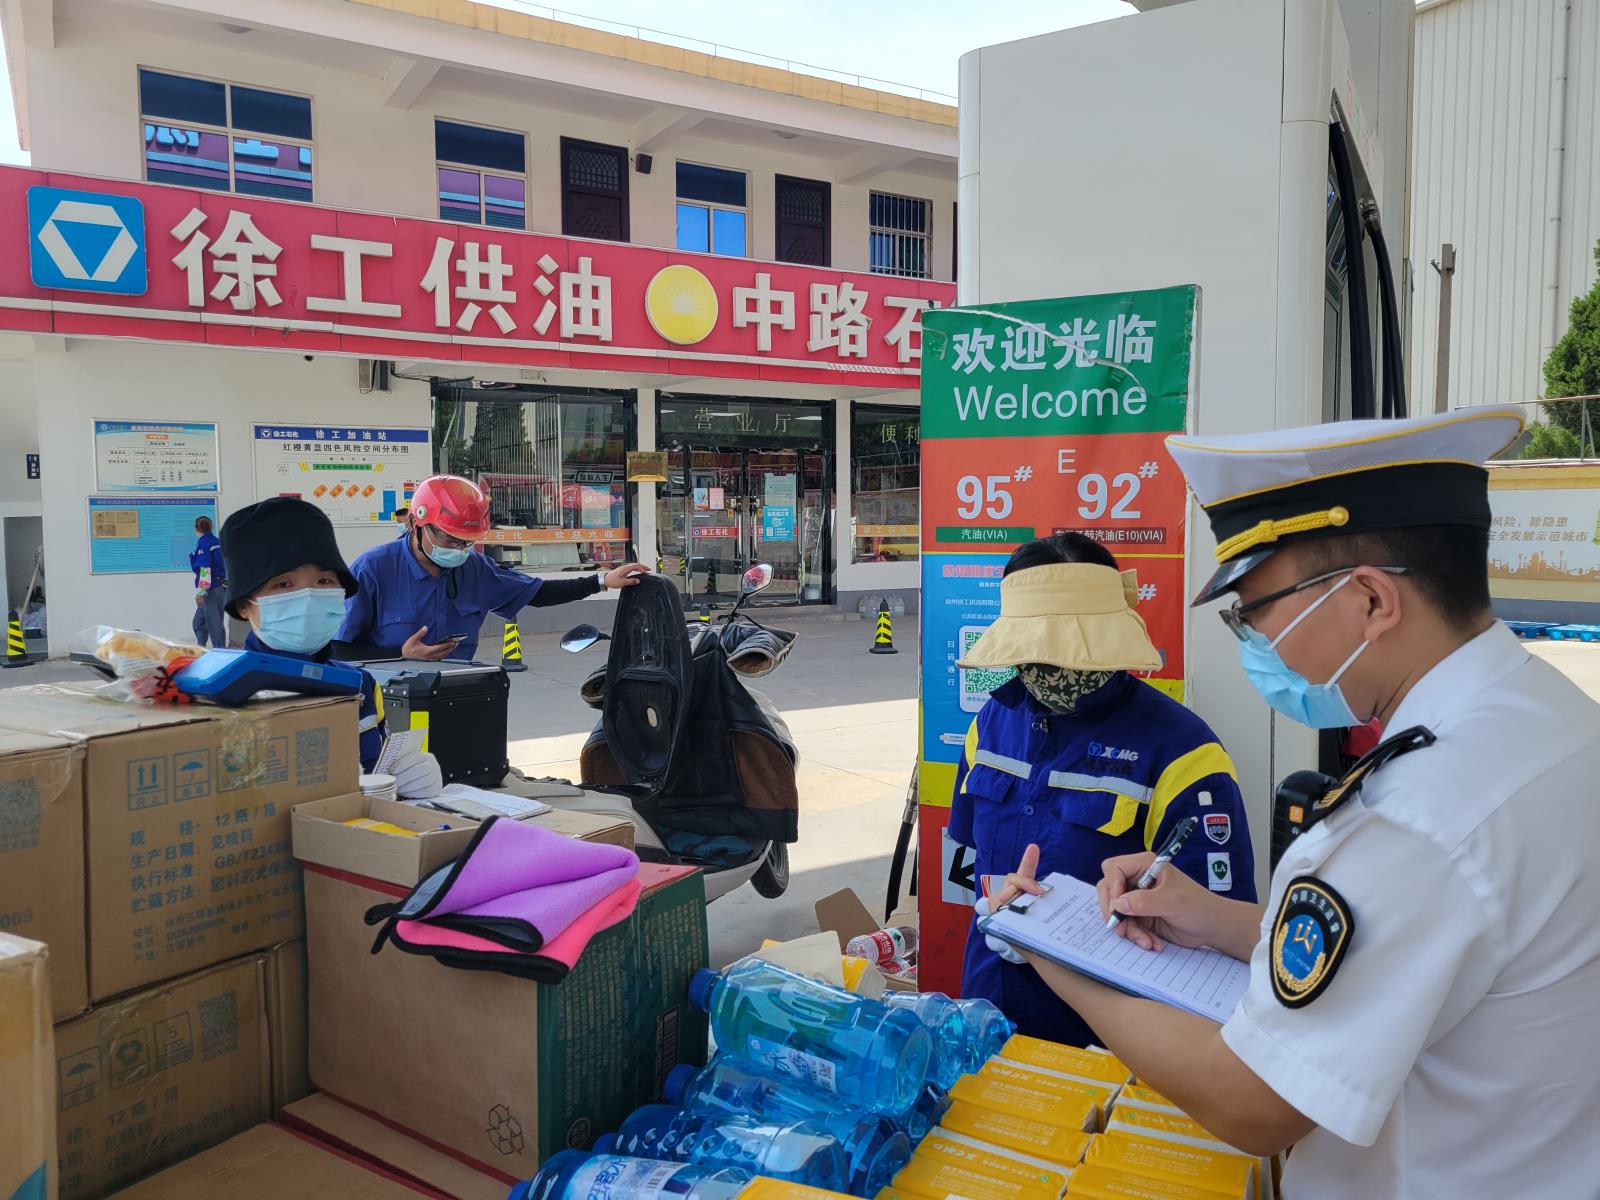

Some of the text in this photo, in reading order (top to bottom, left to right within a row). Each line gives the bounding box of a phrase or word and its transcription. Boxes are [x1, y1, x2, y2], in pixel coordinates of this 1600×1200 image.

[171, 207, 613, 342] 徐工供油
[951, 314, 1157, 375] 欢迎光临
[953, 384, 1147, 421] Welcome
[694, 407, 792, 433] 营业厅
[315, 430, 387, 441] 徐工加油站
[880, 424, 920, 445] 便利
[1057, 448, 1077, 474] E
[701, 528, 729, 536] 徐工石化
[961, 529, 1008, 541] 汽油(VIA)
[1100, 746, 1139, 761] XCMG
[1214, 864, 1227, 873] LA
